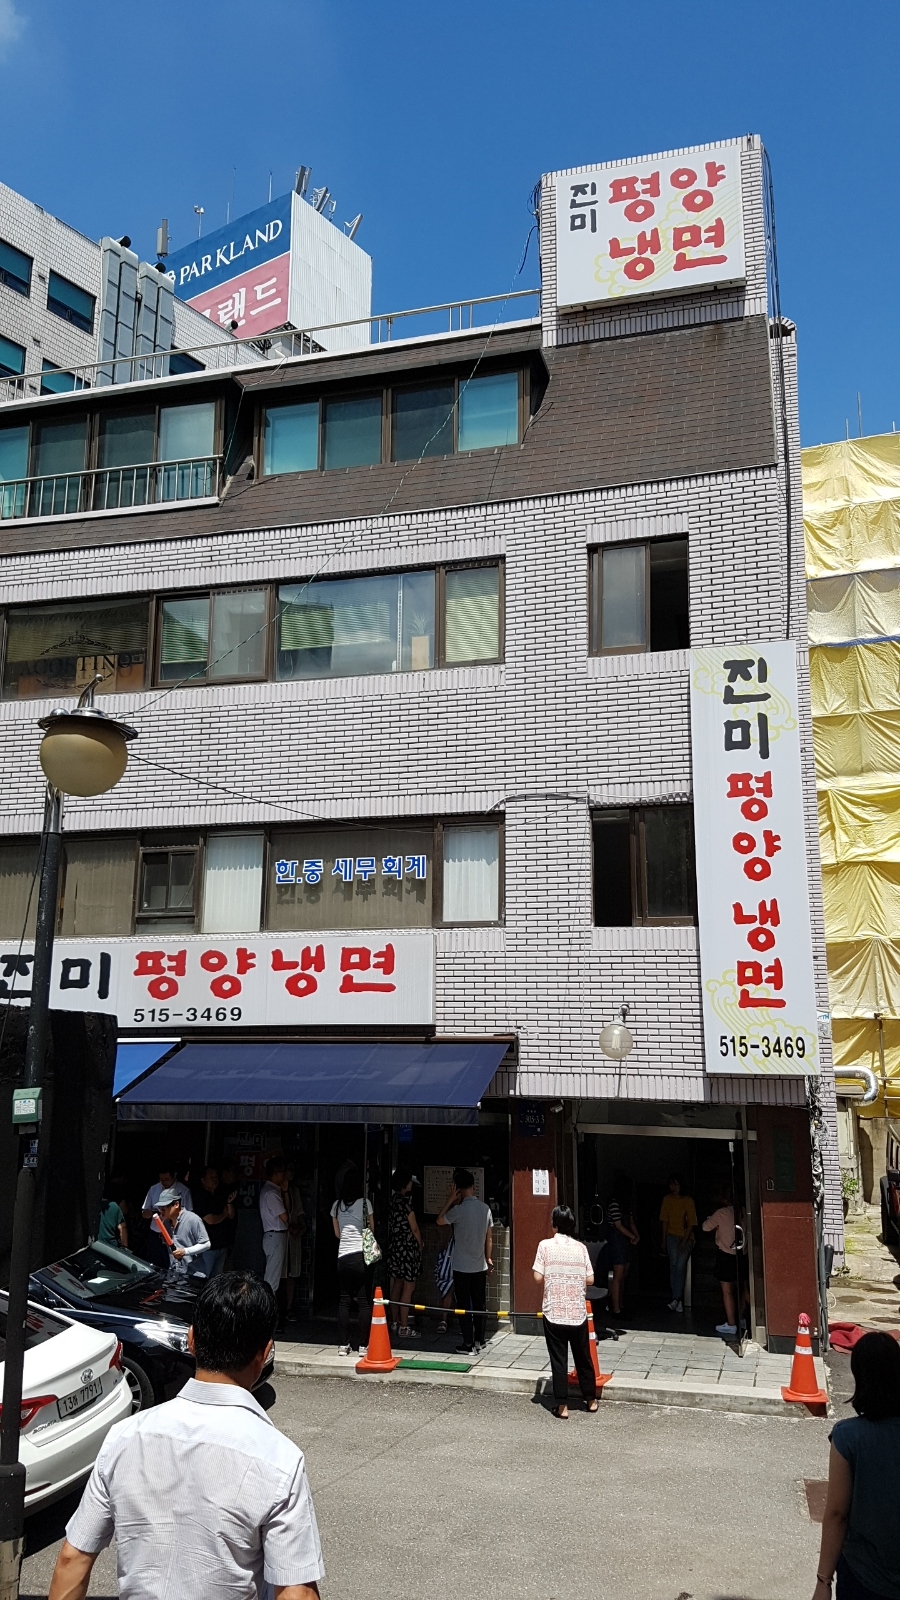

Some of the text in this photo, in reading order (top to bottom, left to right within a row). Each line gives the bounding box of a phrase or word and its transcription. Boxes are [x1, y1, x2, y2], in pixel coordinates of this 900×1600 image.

[570, 181, 598, 233] 진미
[608, 161, 726, 222] 평양
[179, 219, 283, 286] PARKLAND
[608, 217, 728, 280] 냉면
[201, 277, 282, 328] 랜드
[722, 656, 772, 760] 진미
[134, 943, 396, 1000] 평양냉면
[133, 1006, 243, 1023] 515-3469
[719, 1035, 806, 1058] 515-3469
[80, 1382, 98, 1402] 7791
